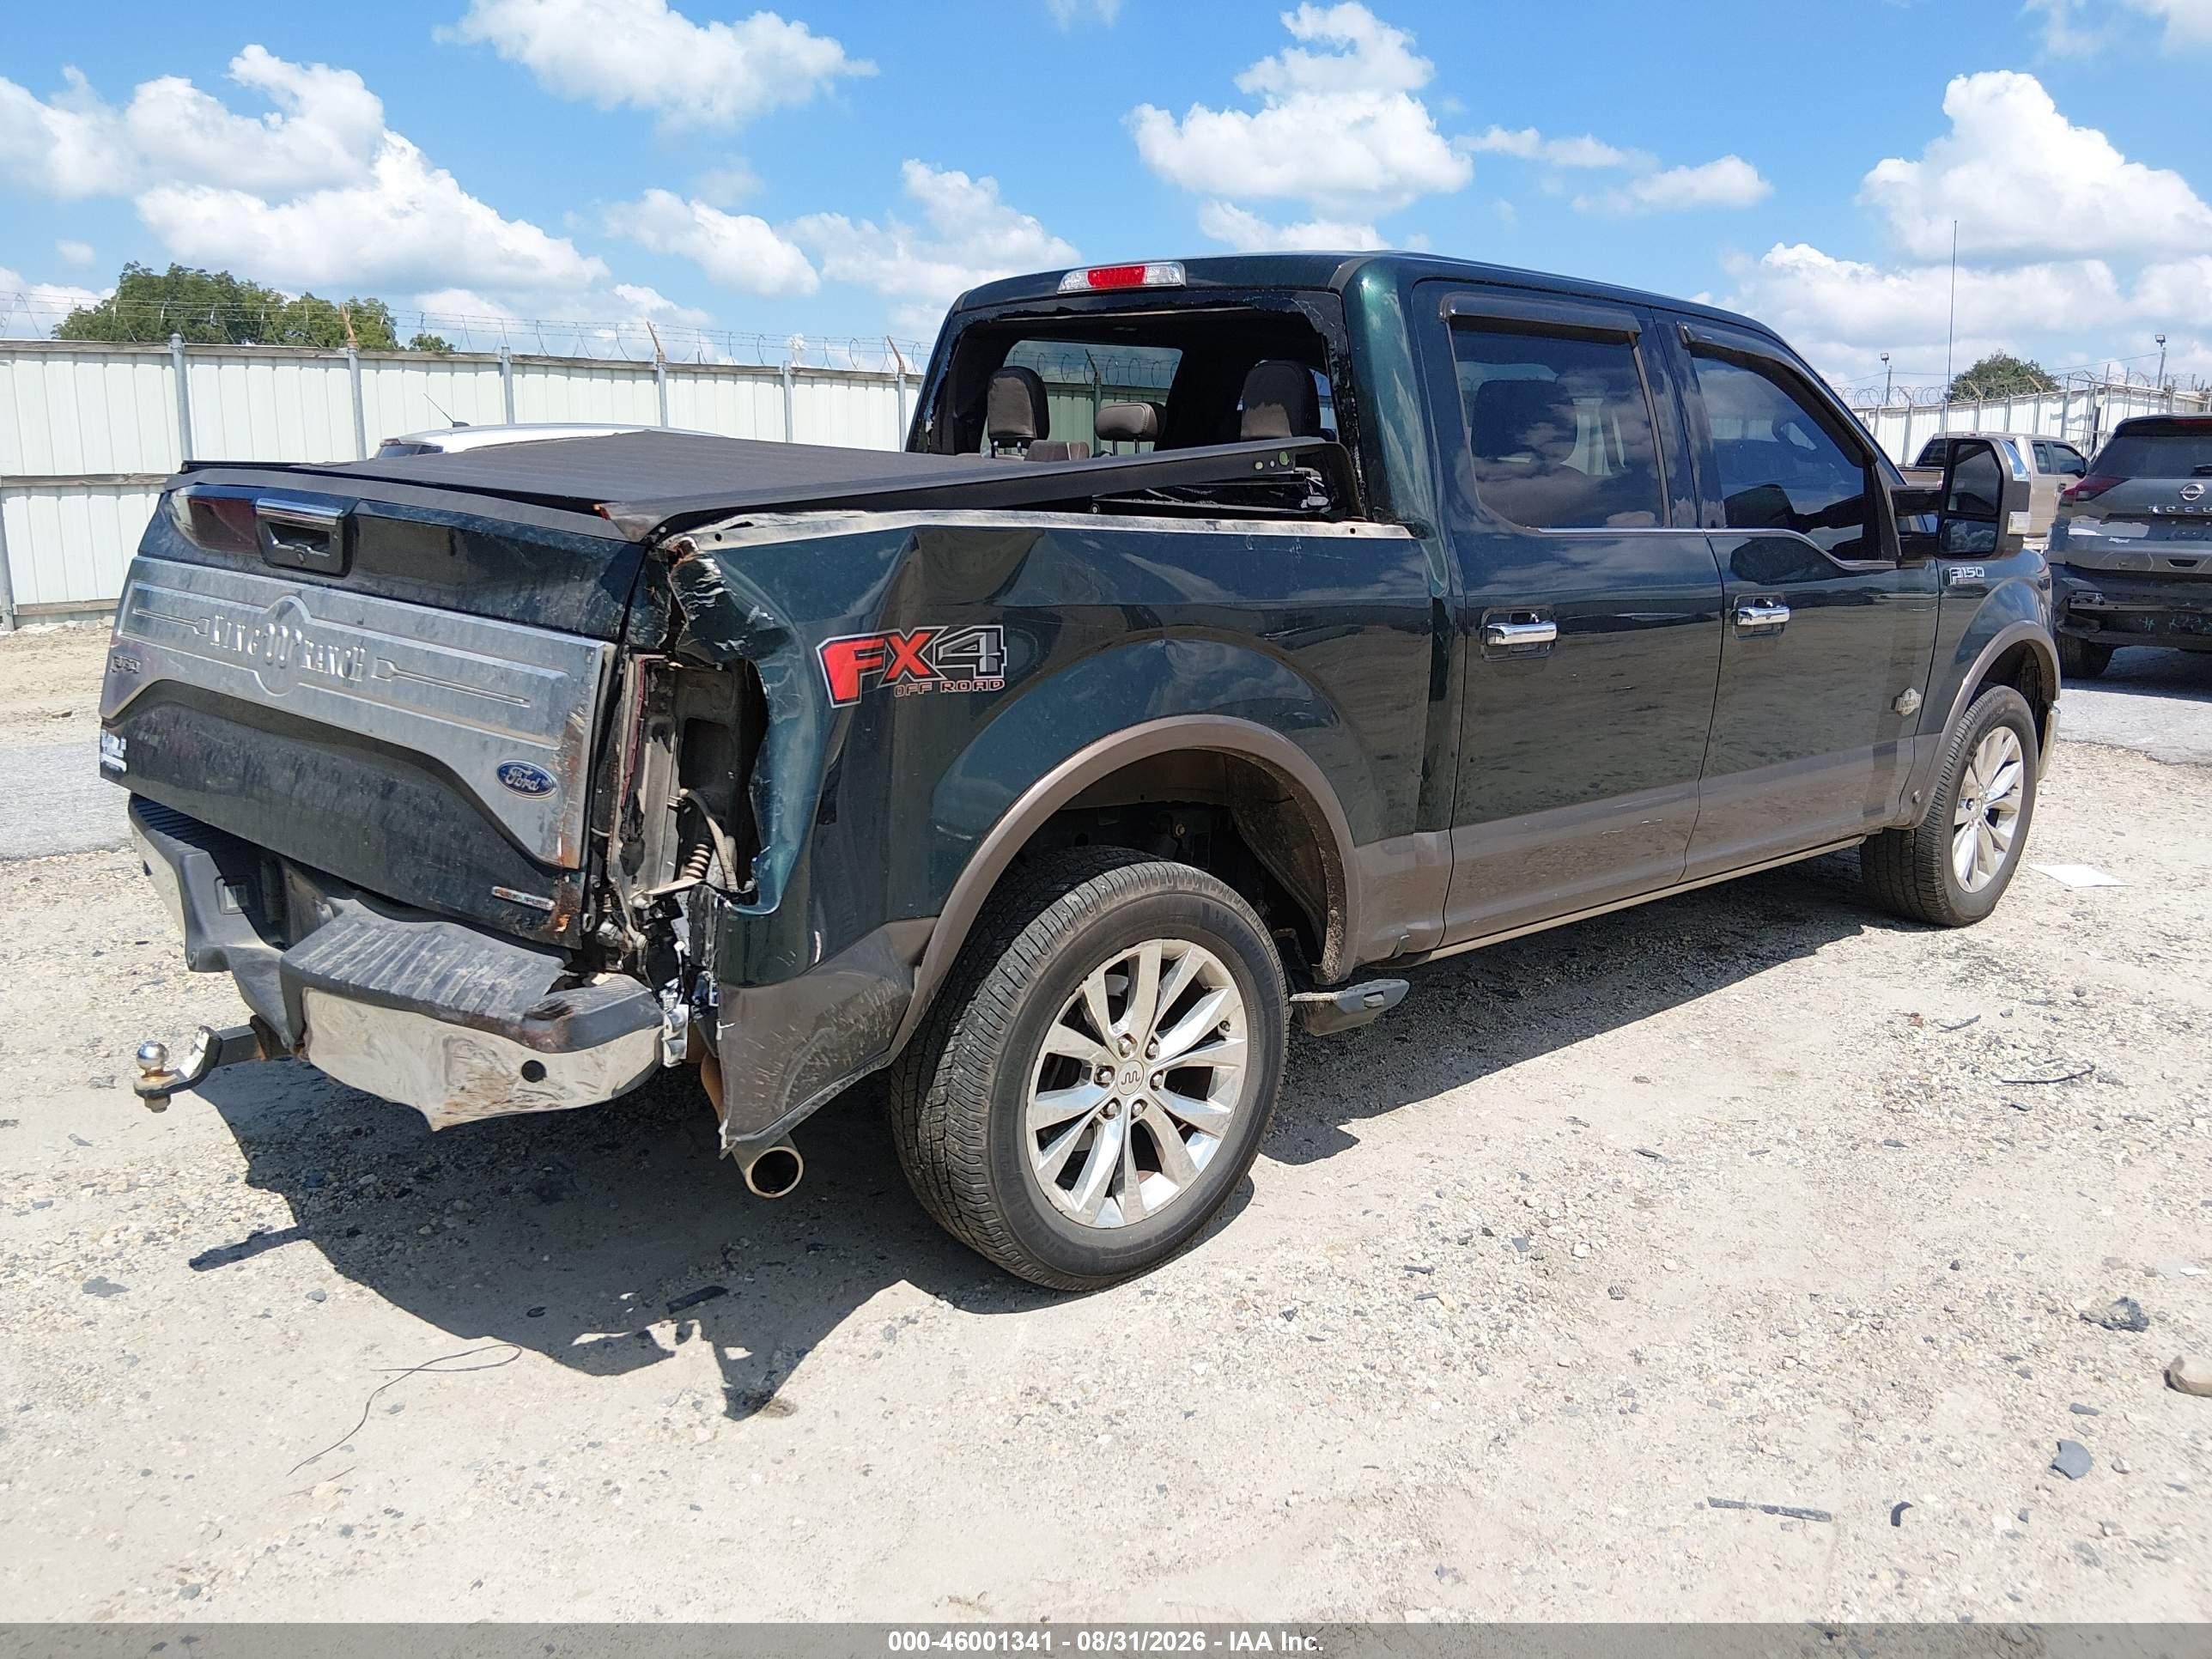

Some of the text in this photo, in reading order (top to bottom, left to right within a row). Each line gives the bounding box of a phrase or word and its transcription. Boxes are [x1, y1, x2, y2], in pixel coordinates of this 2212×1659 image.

[301, 639, 368, 682] RANCH
[816, 625, 1007, 708] FX4
[894, 679, 1006, 697] OFF ROAD
[505, 767, 541, 791] Ford
